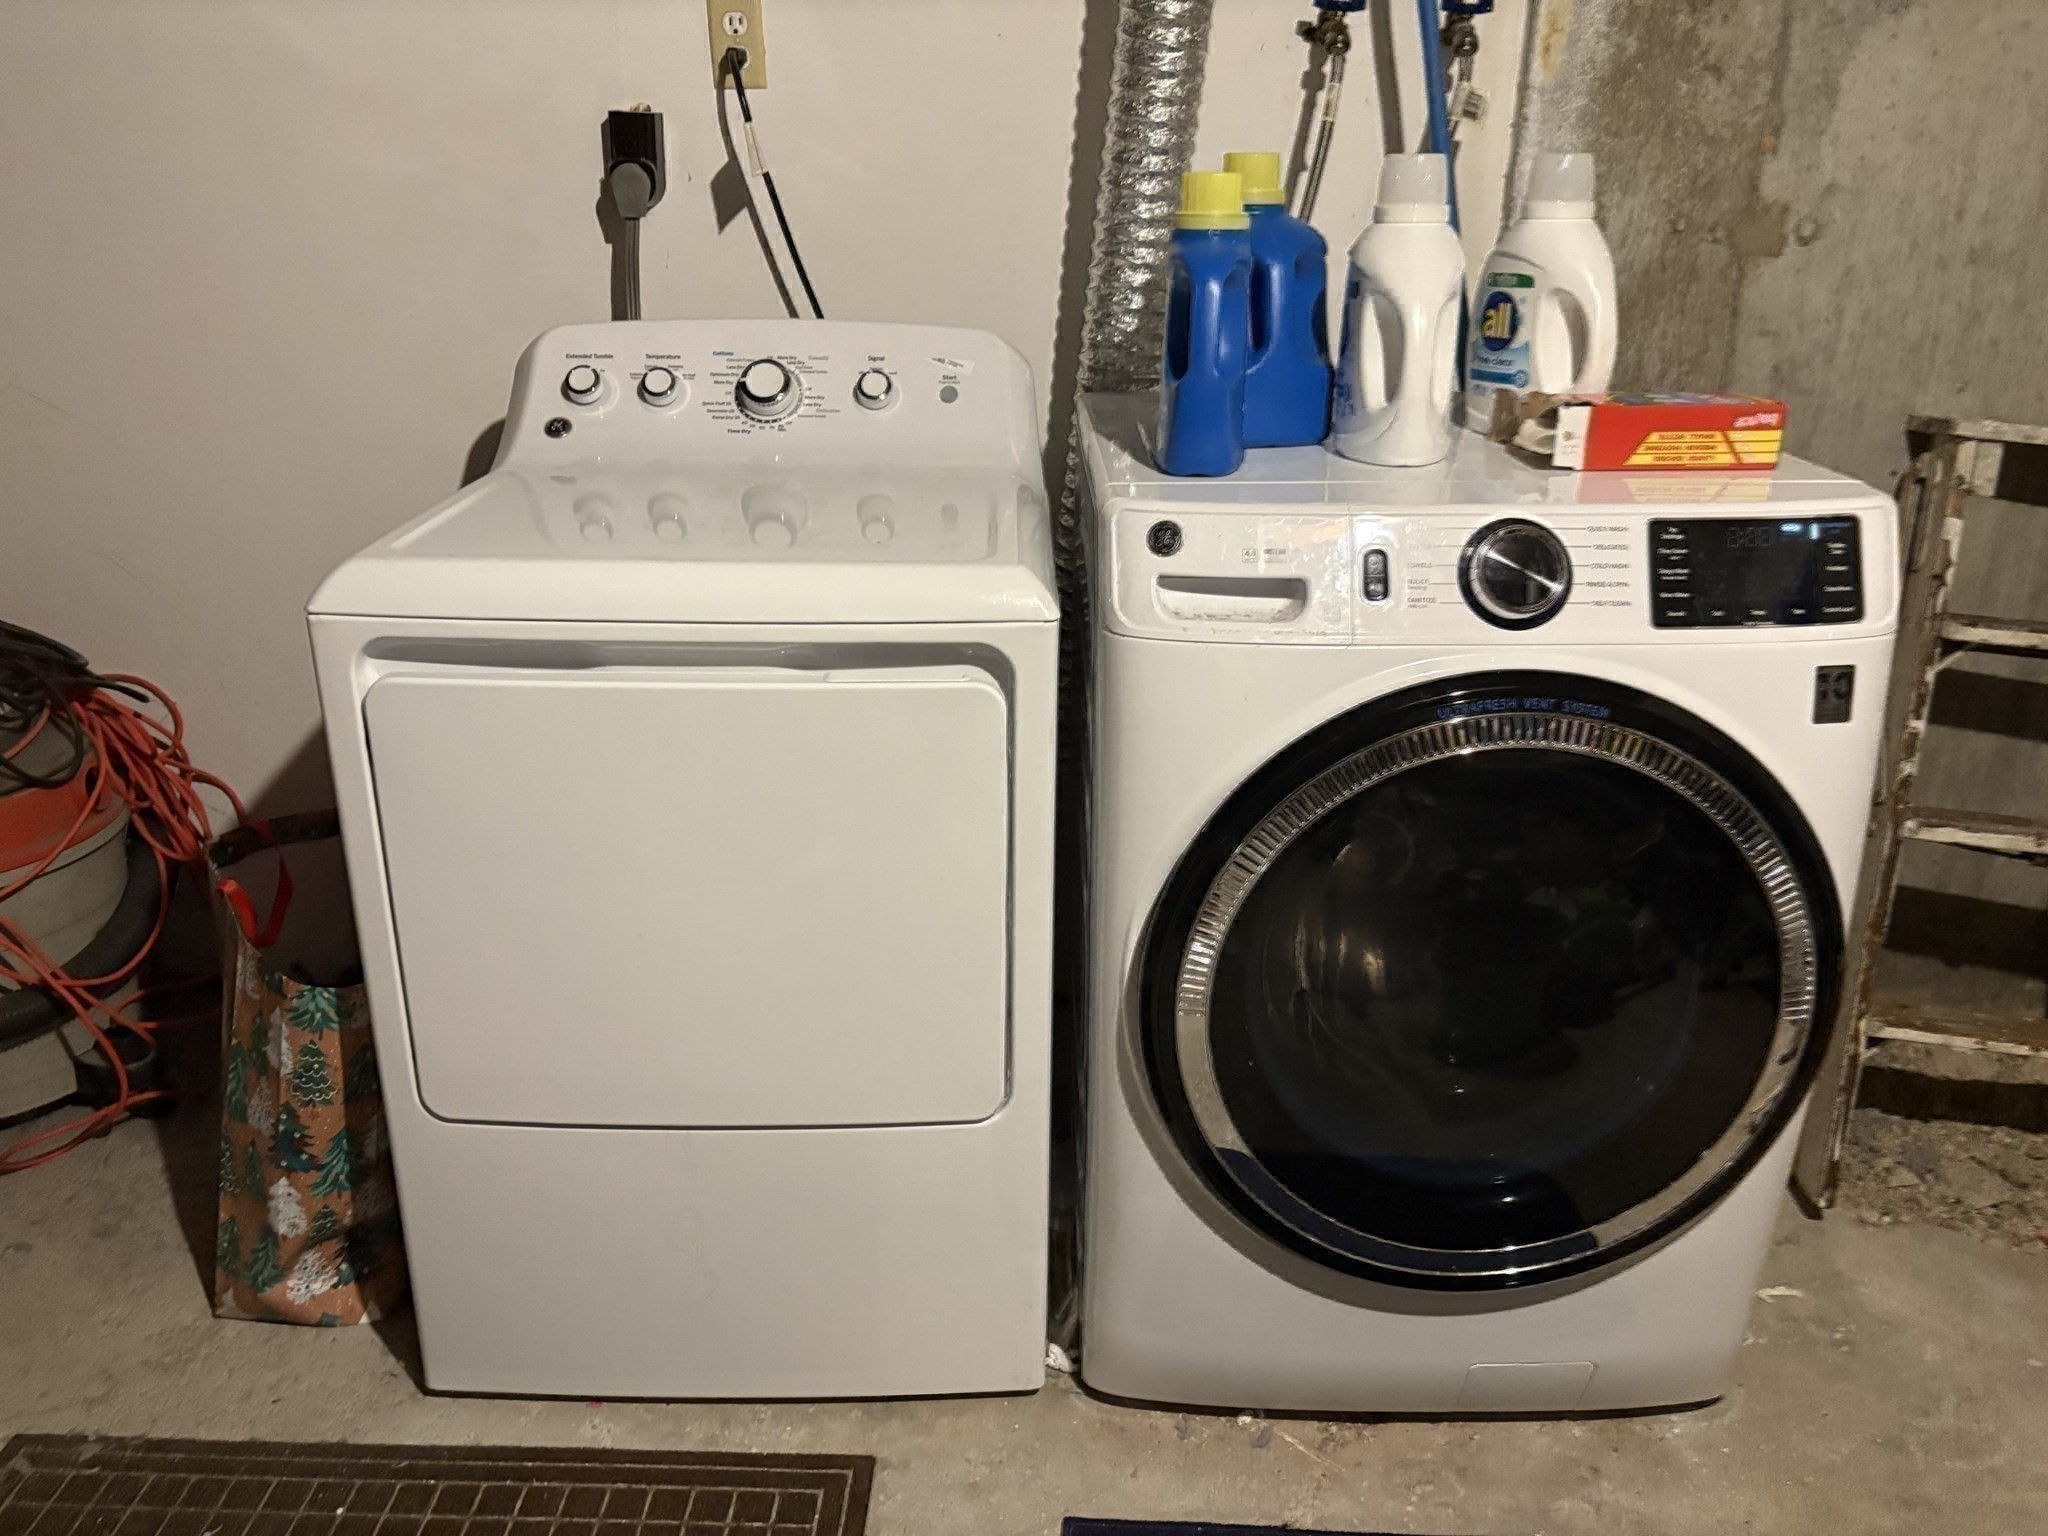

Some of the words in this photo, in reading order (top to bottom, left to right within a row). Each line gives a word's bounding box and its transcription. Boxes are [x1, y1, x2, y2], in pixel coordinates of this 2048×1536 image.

[1481, 302, 1512, 338] all
[1436, 698, 1517, 719] ULTRAFRESH
[1522, 698, 1555, 711] VENT
